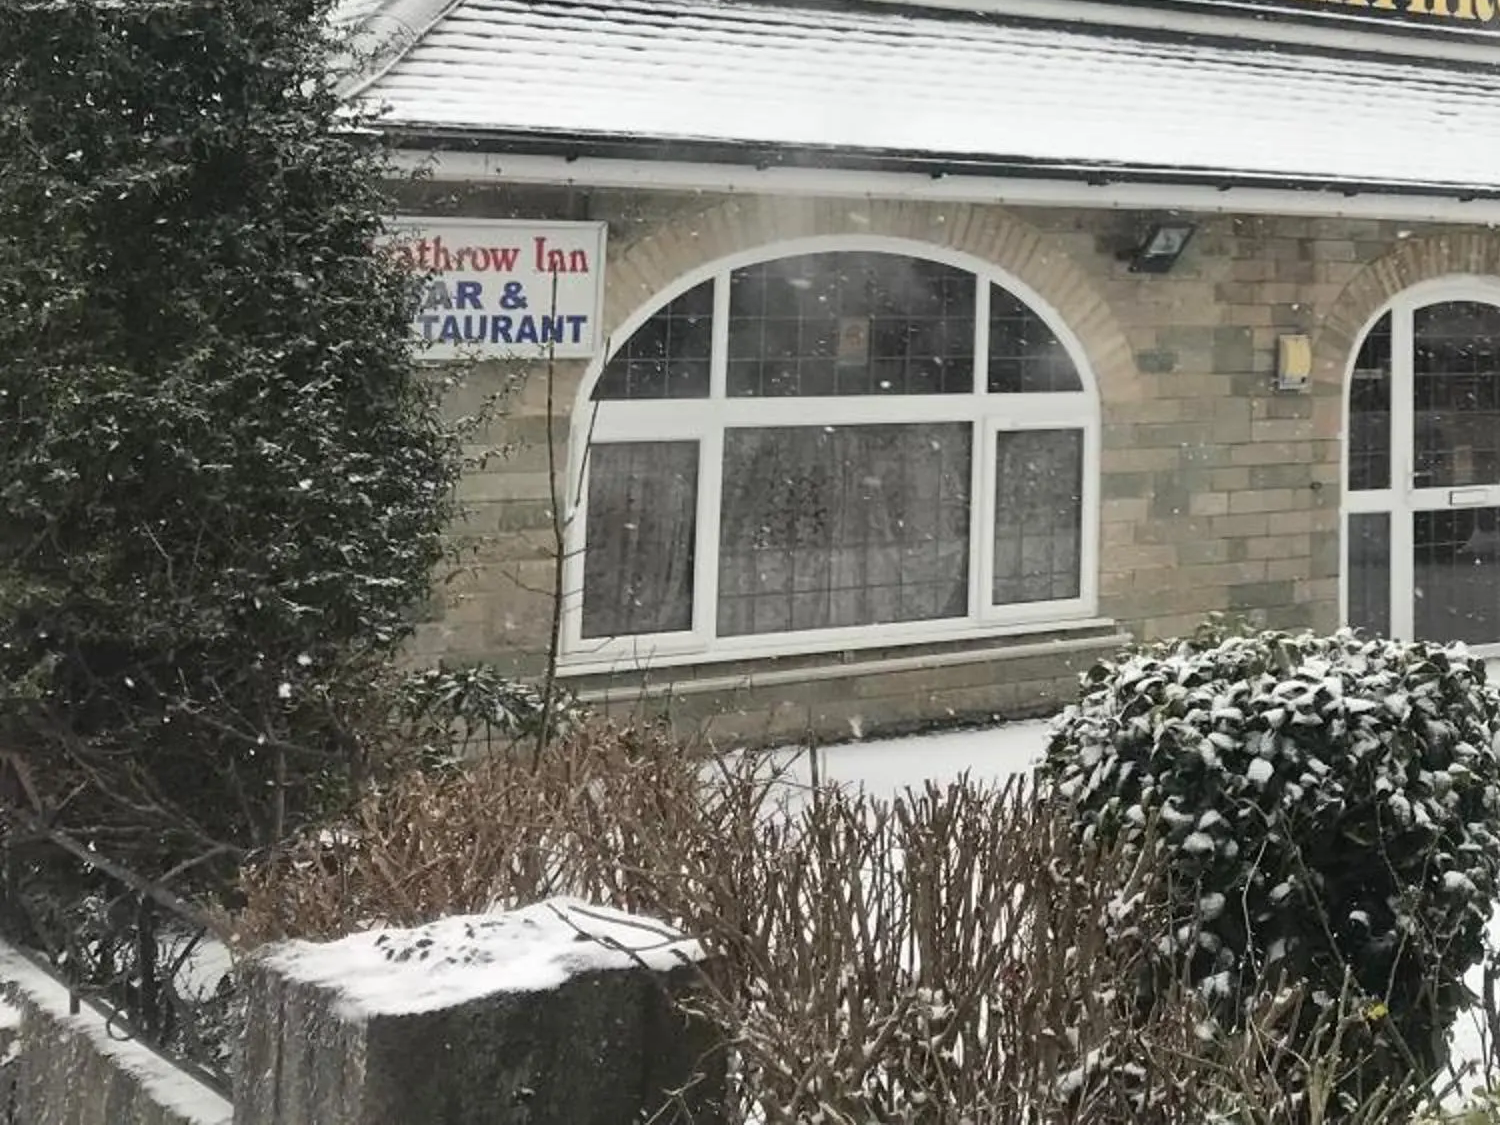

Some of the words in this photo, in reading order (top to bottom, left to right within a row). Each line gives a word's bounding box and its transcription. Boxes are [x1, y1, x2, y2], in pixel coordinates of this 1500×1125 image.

[391, 235, 520, 273] athrow
[534, 236, 589, 273] Inn
[422, 280, 483, 310] AR
[500, 281, 529, 310] &
[416, 315, 588, 344] TAURANT
